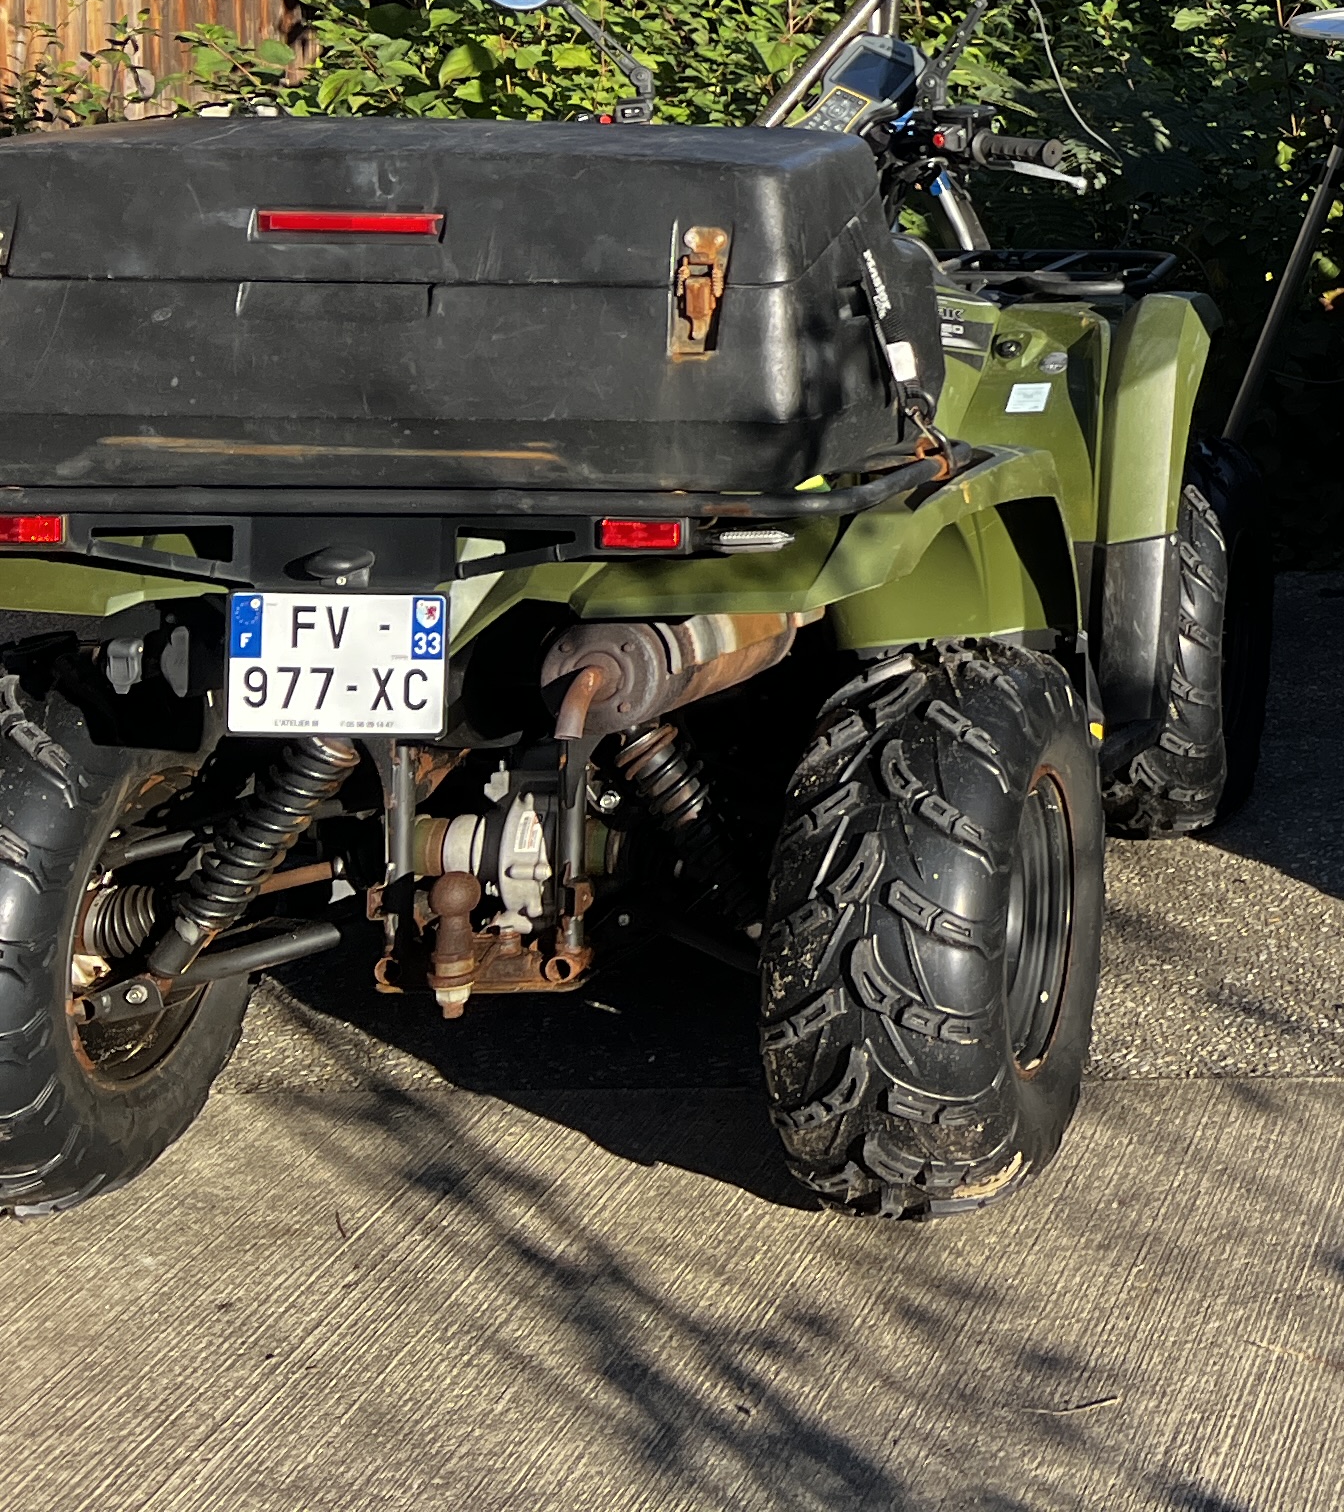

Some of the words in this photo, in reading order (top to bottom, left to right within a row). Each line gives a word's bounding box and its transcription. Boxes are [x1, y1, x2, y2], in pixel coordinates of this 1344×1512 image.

[240, 633, 252, 648] F
[291, 605, 350, 649] FV
[413, 632, 441, 655] 33
[243, 666, 428, 711] 977-XC
